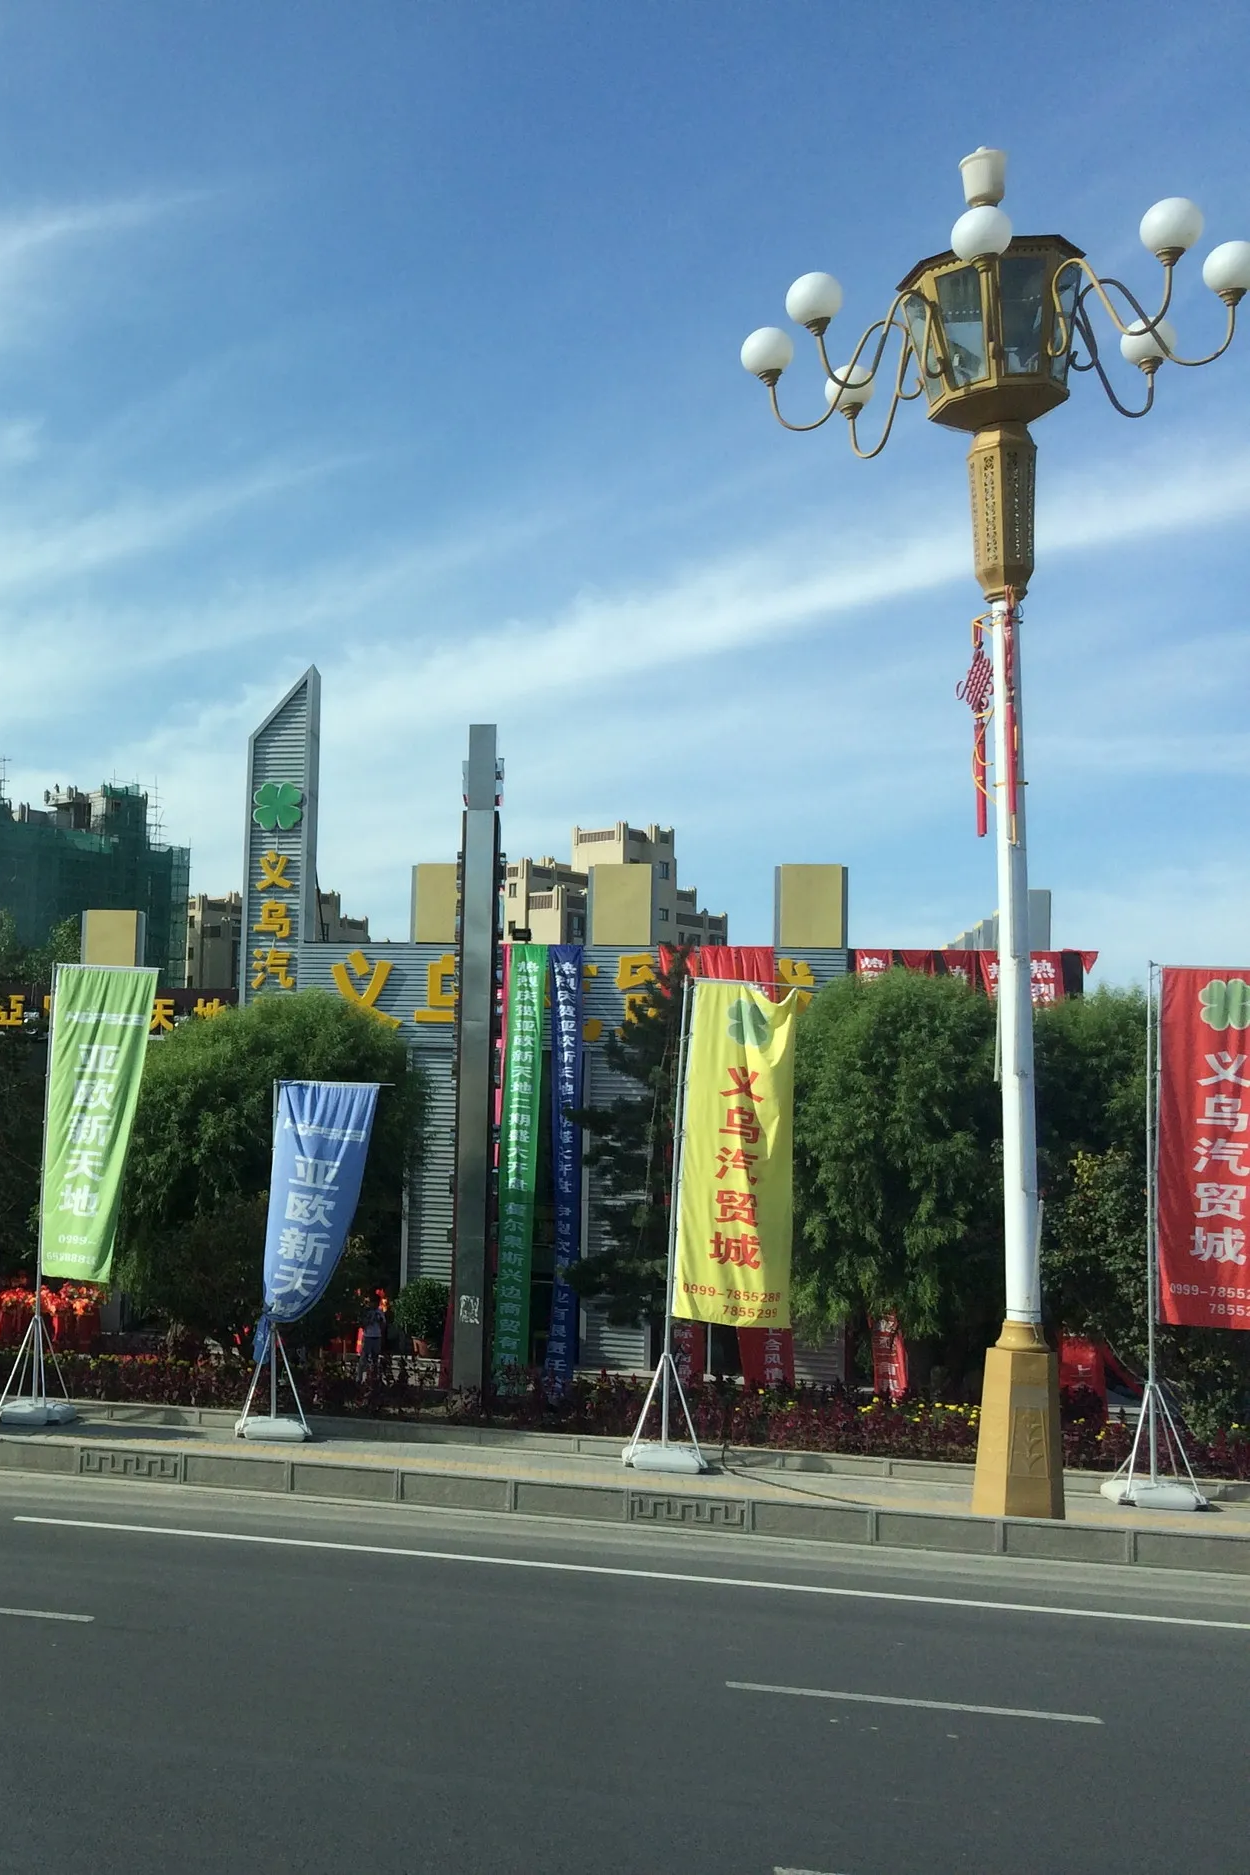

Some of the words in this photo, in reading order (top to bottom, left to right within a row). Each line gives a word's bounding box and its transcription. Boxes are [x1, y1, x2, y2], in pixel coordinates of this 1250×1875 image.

[252, 850, 296, 989] 义乌汽
[59, 1043, 121, 1218] 亚欧新天地
[709, 1066, 764, 1270] 义乌汽贸城
[1190, 1051, 1250, 1266] 义乌汽贸城
